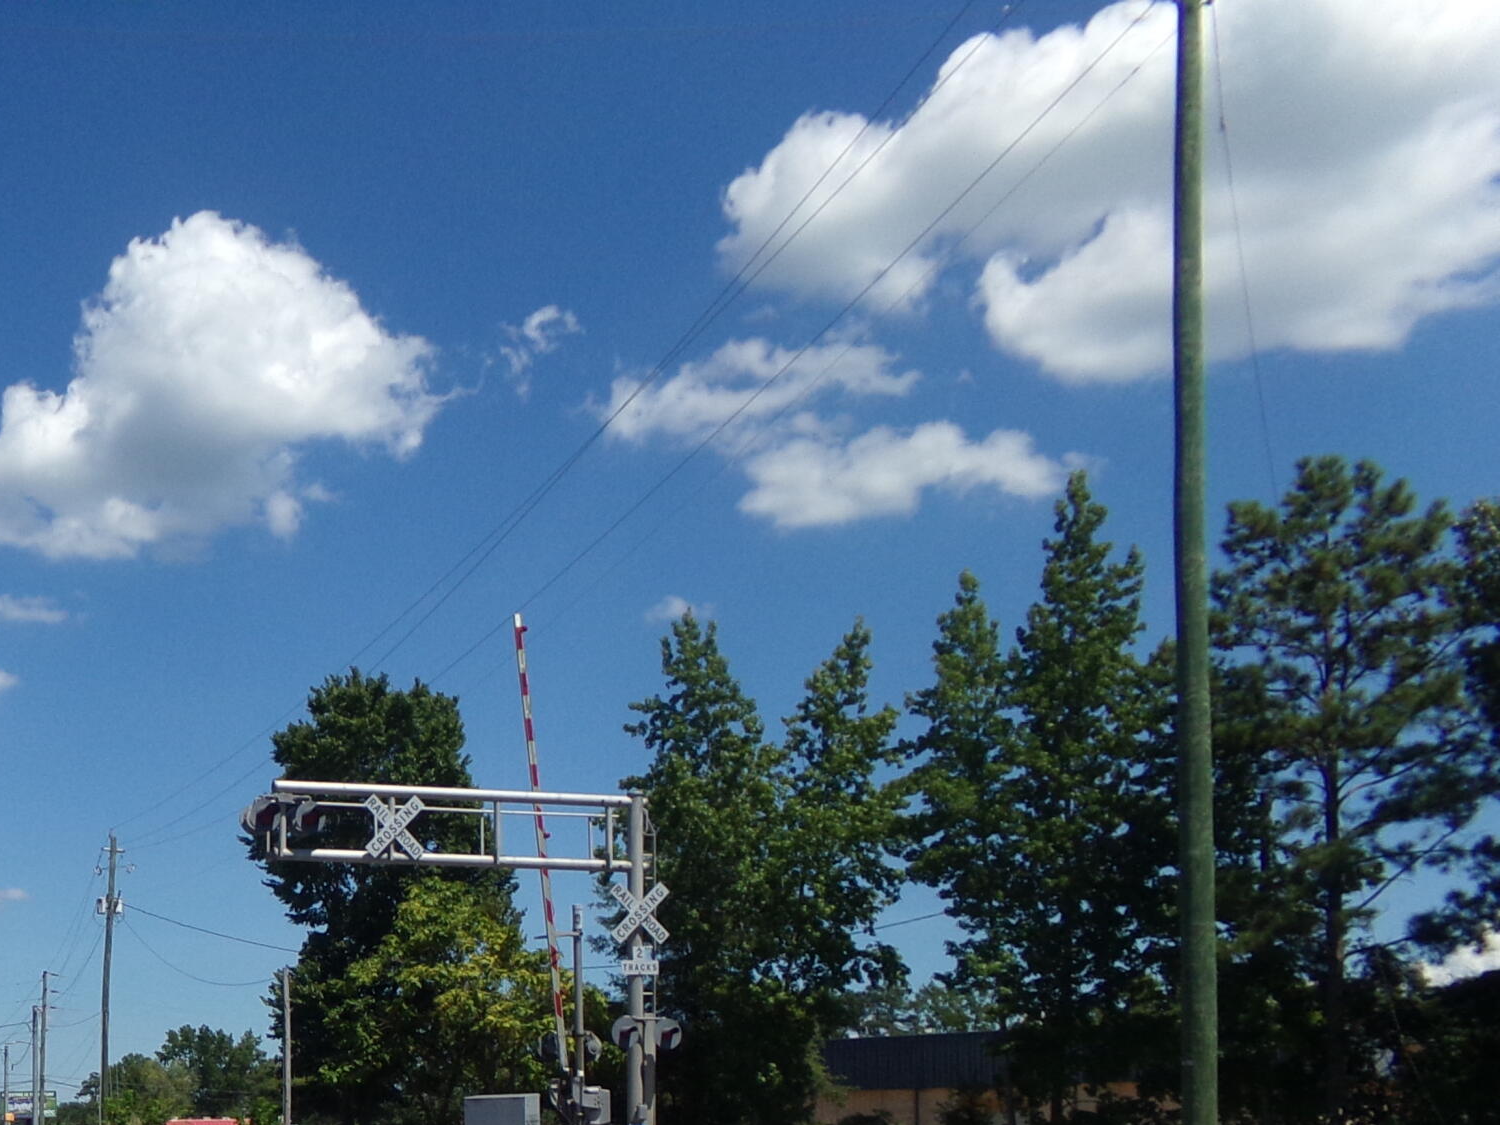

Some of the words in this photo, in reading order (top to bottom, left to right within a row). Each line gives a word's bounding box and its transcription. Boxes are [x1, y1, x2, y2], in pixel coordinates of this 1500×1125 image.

[368, 798, 389, 823] RAIL
[397, 830, 421, 856] ROAD
[371, 801, 419, 852] CROSSING
[613, 885, 634, 910] RAIL
[643, 917, 667, 940] ROAD
[616, 887, 665, 938] CROSSING
[623, 963, 658, 972] TRACKS
[636, 948, 643, 959] 2
